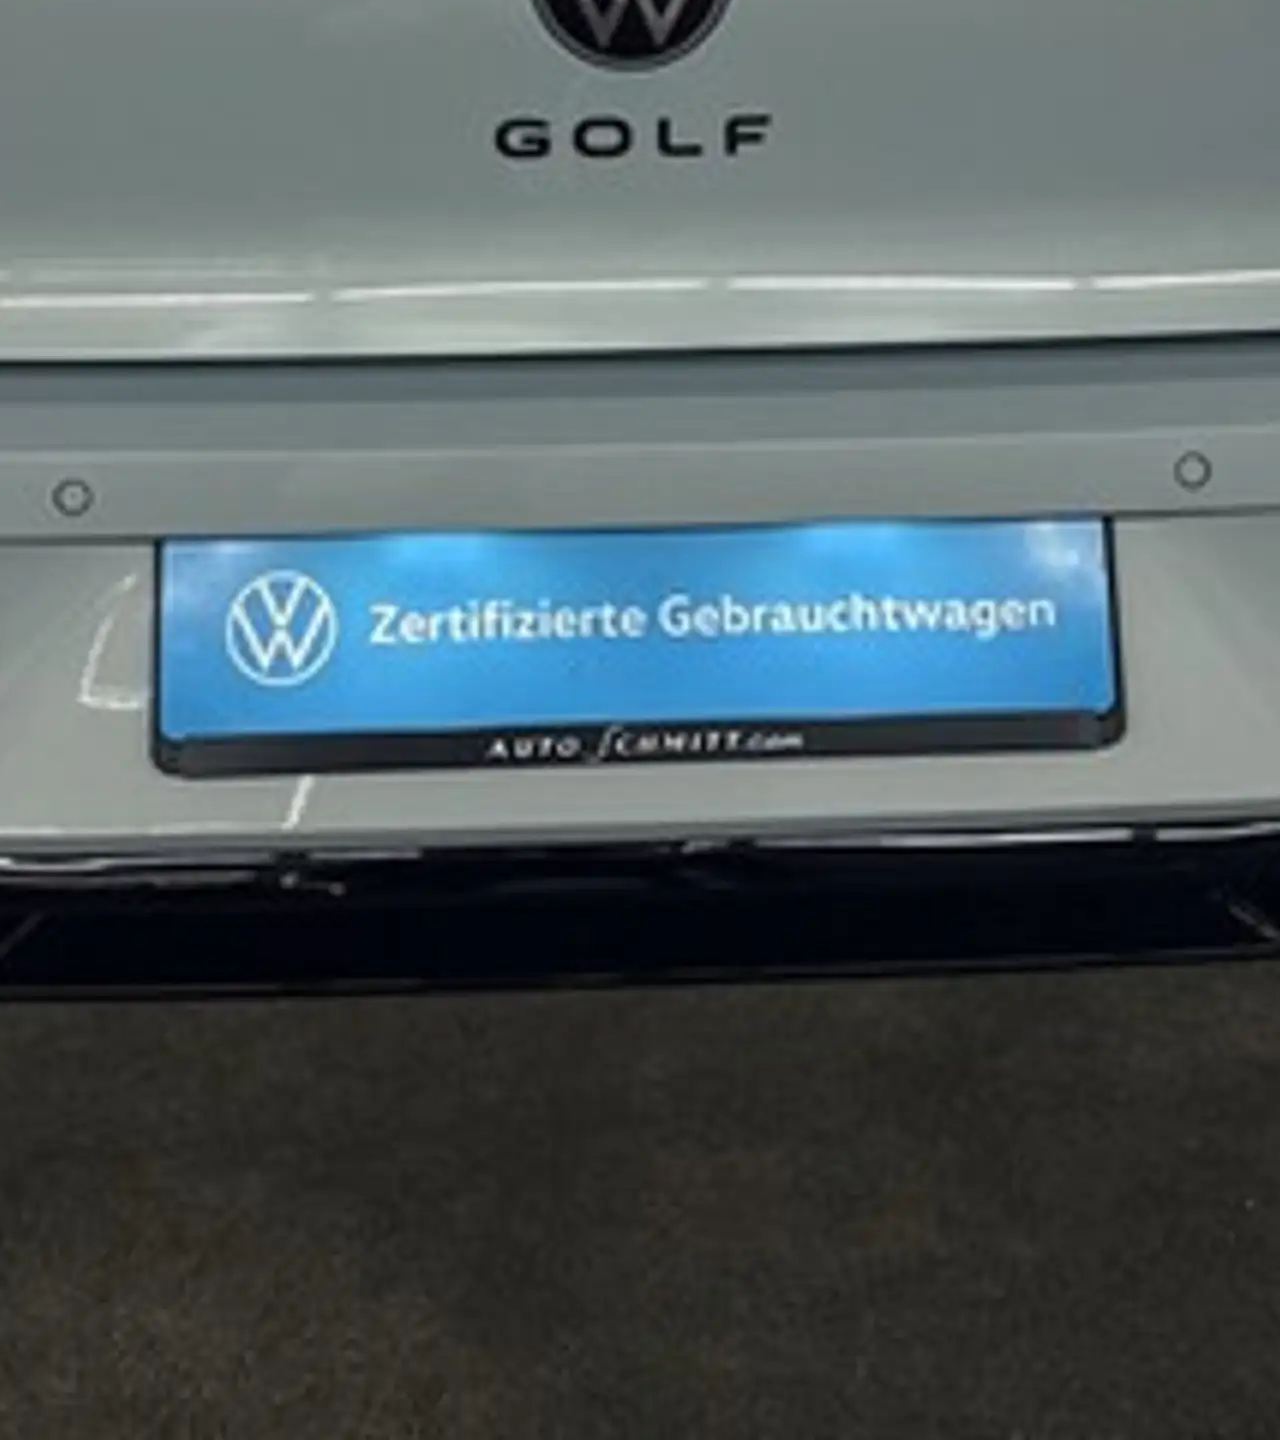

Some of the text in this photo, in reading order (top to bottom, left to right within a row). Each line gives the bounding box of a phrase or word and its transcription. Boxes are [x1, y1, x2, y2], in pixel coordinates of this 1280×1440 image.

[494, 113, 772, 159] GOLF
[370, 593, 1057, 647] Zertifizierte Gebrauchtwagen
[486, 735, 580, 759] AUTO
